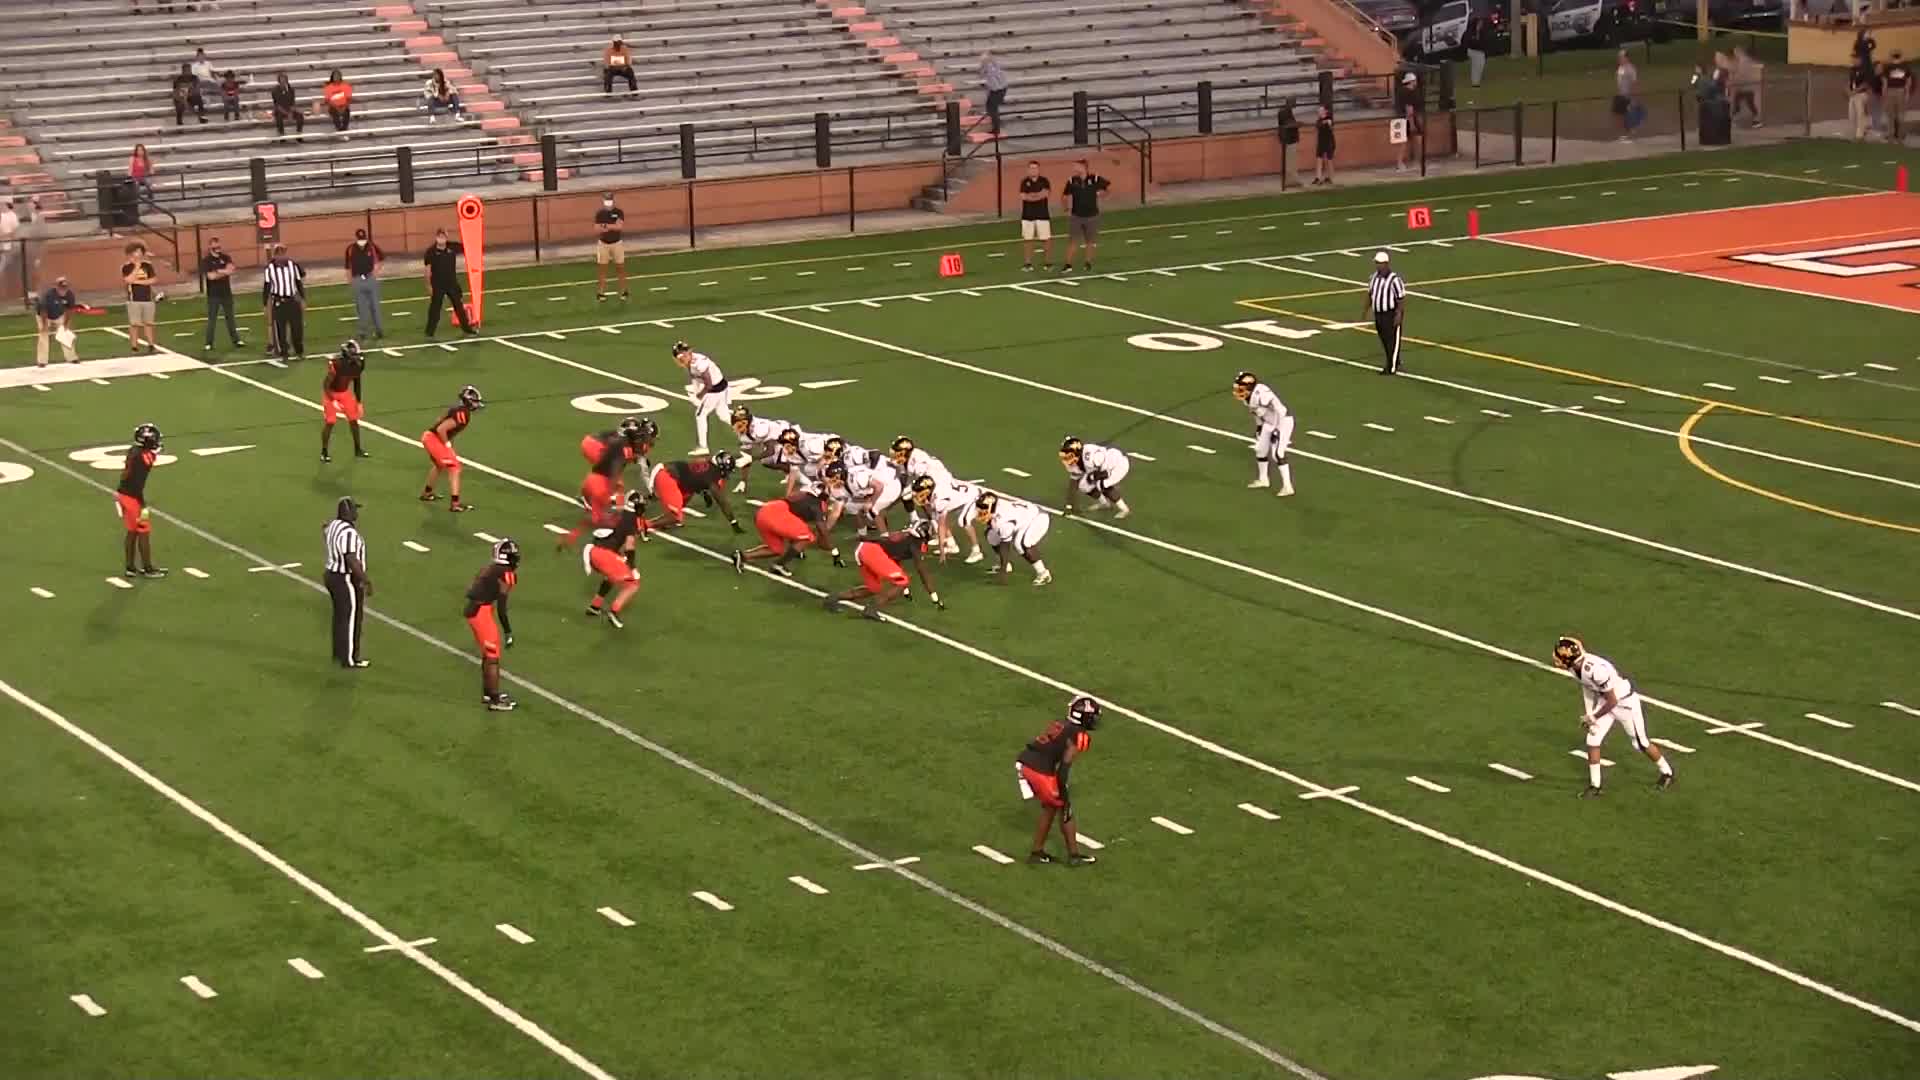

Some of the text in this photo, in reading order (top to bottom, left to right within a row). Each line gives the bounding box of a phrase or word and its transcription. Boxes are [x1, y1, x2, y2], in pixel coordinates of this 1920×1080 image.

[258, 204, 276, 228] 3
[1415, 210, 1425, 226] G
[946, 257, 961, 274] 10
